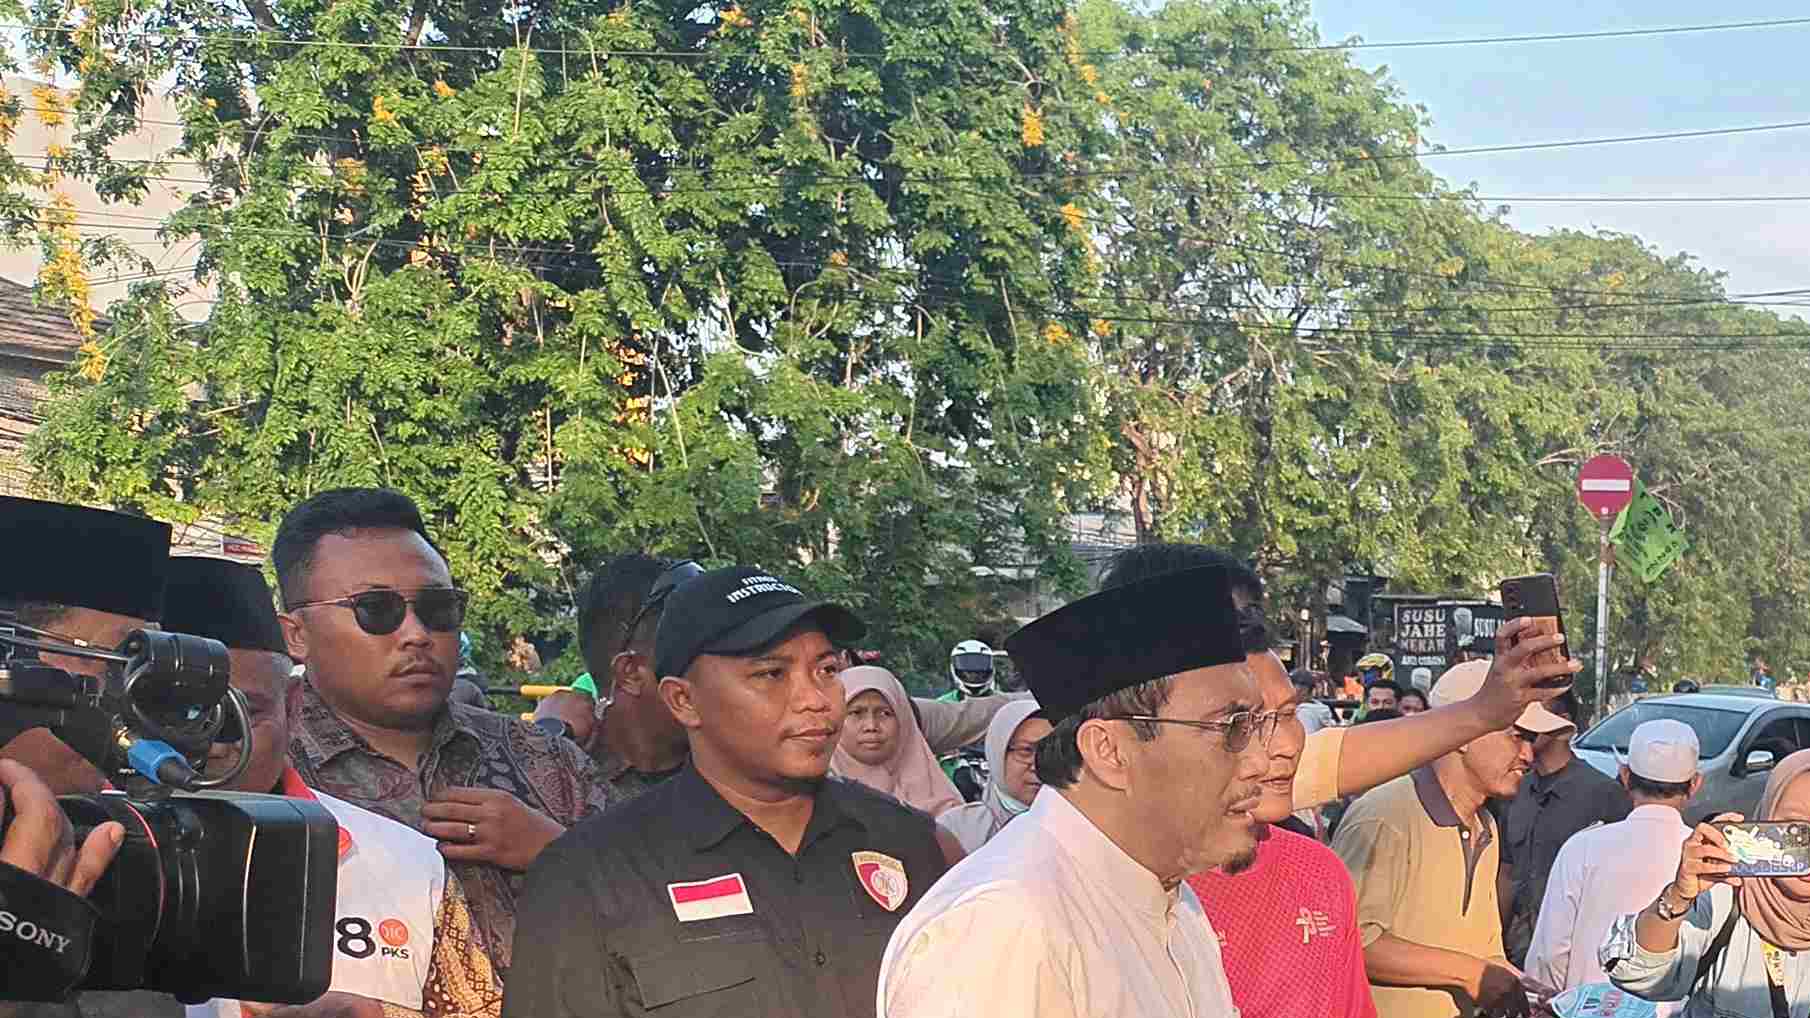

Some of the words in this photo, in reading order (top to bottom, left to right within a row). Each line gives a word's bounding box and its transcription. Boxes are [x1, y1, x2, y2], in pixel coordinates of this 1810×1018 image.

[1401, 608, 1446, 623] SUSU
[1400, 624, 1446, 638] JAHE
[1474, 618, 1496, 637] SUSU
[0, 910, 71, 953] SONY
[381, 947, 409, 959] PKS
